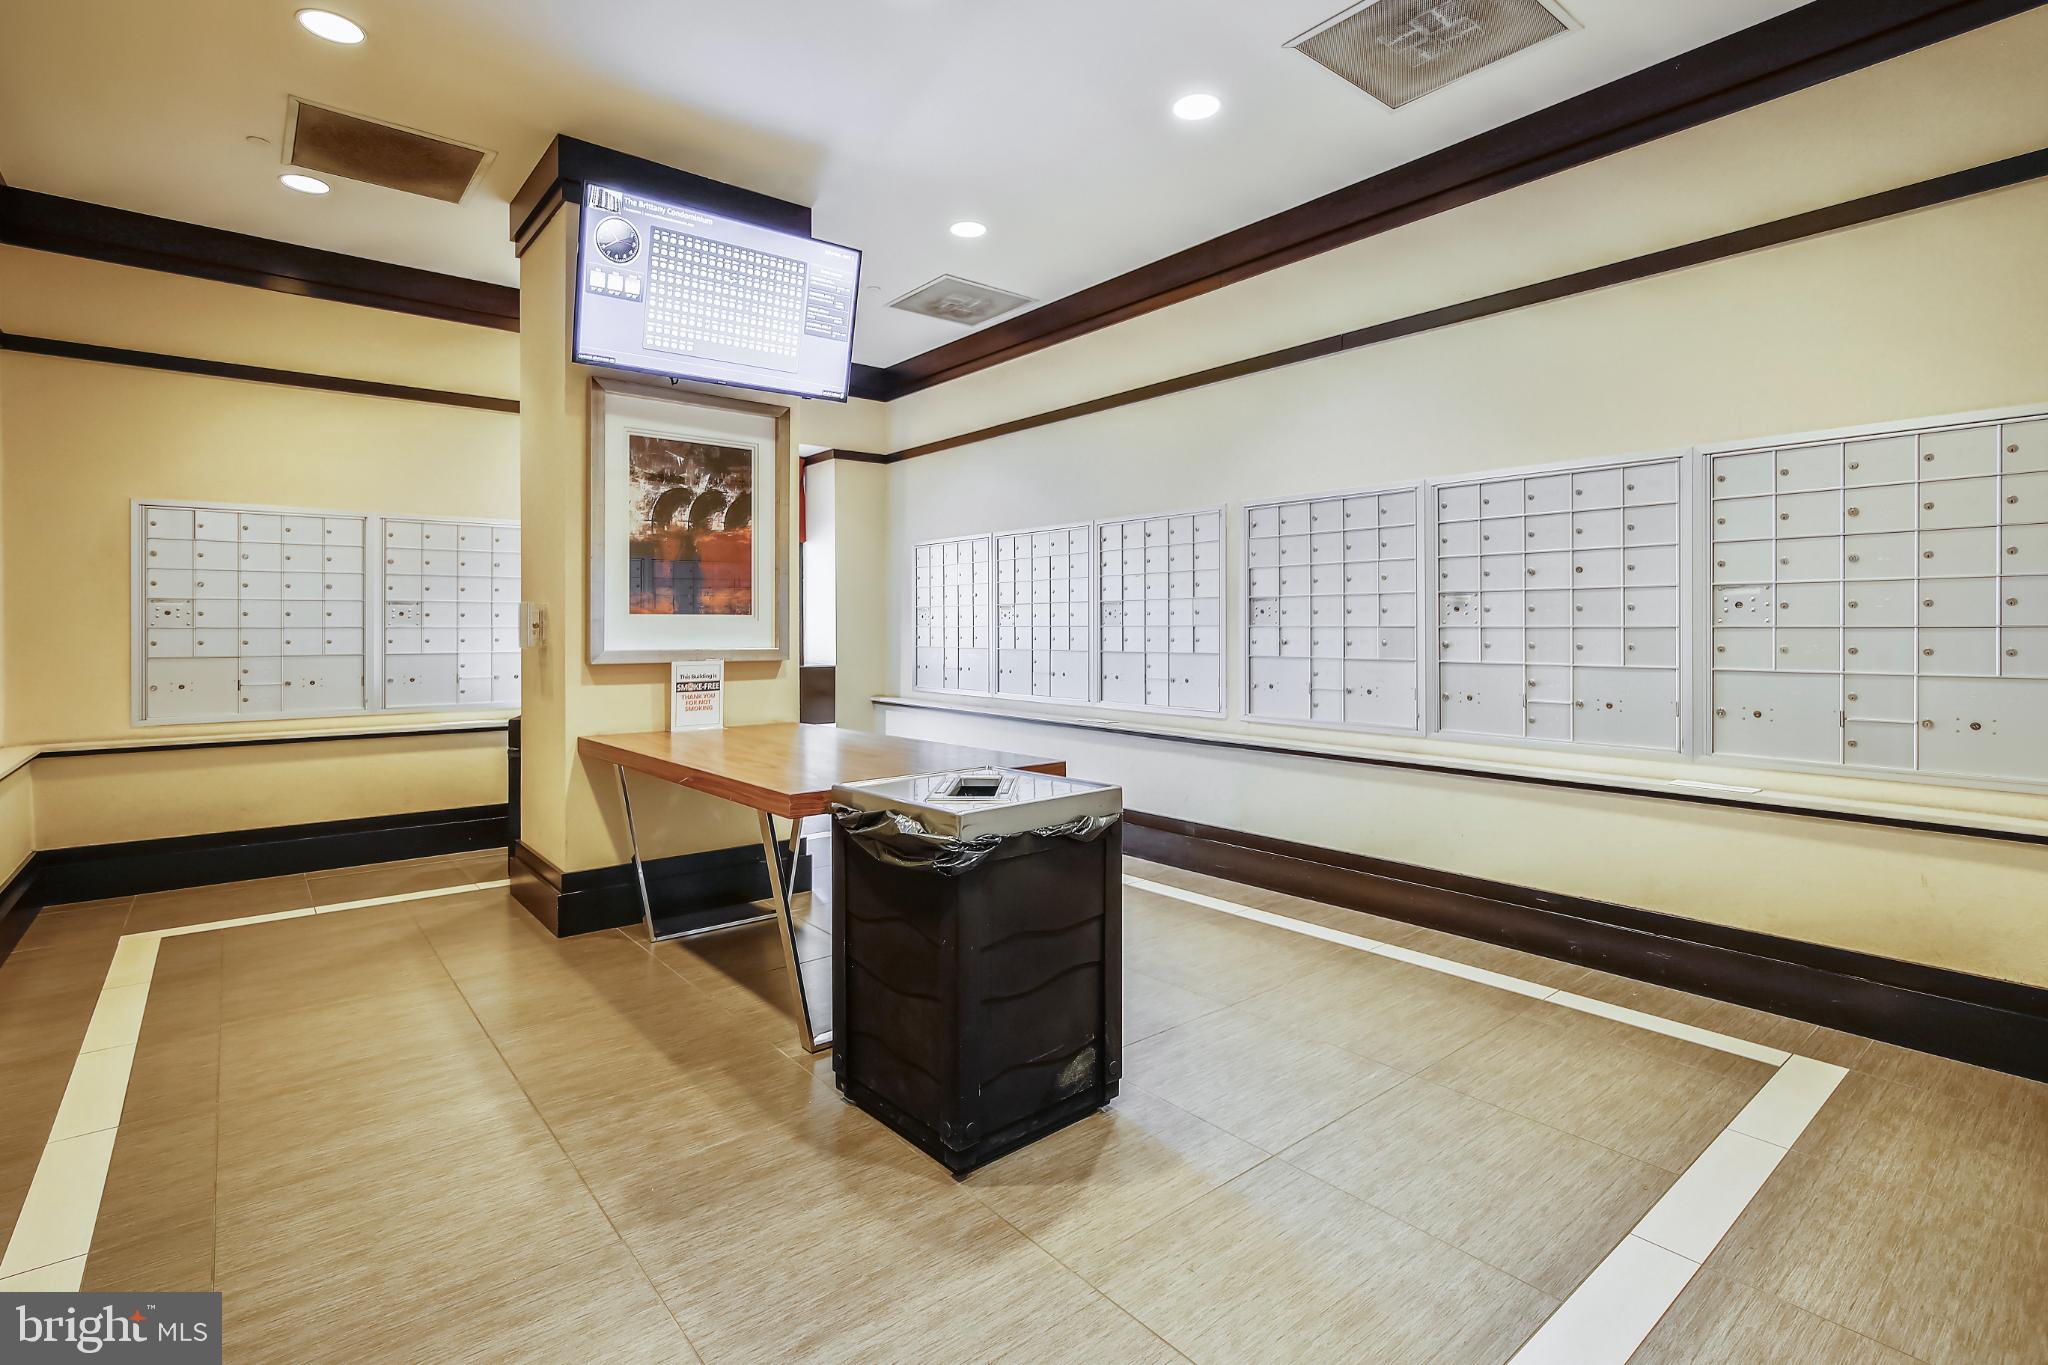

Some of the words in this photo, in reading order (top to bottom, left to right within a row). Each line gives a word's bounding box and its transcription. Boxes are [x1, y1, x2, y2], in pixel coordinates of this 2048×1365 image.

[624, 196, 638, 207] The
[638, 200, 666, 215] Brittany
[667, 207, 713, 225] Condominium
